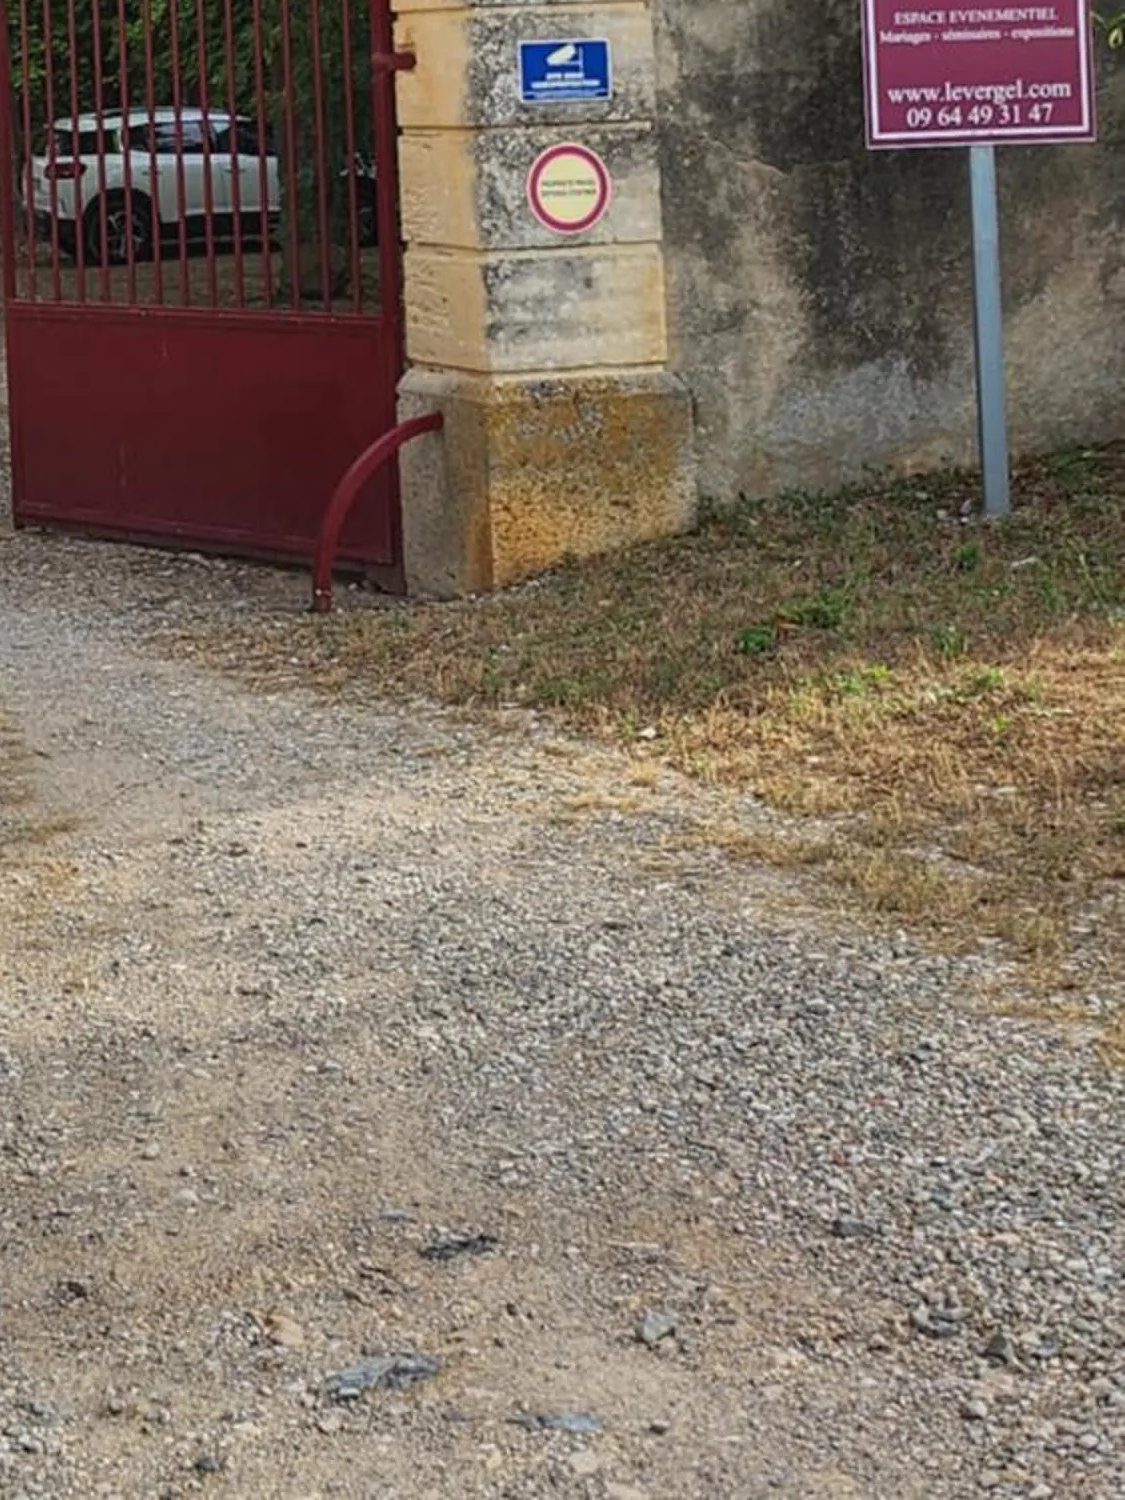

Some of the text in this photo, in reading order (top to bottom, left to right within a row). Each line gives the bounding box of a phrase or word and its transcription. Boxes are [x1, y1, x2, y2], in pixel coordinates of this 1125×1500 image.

[894, 10, 946, 25] ESPACE
[887, 78, 1072, 105] www.levergel.com
[906, 102, 1054, 128] 09 64 49 31 47
